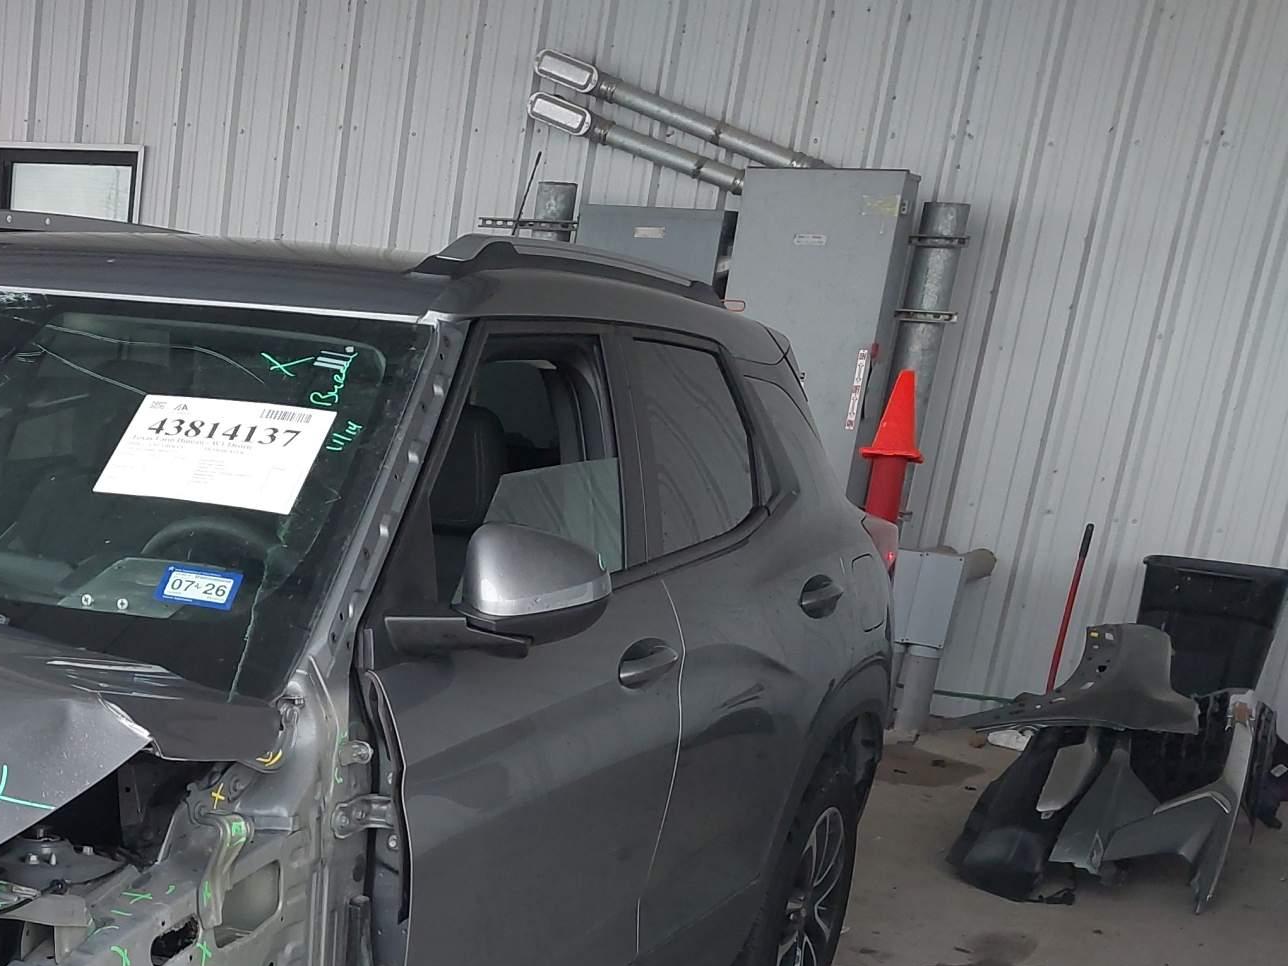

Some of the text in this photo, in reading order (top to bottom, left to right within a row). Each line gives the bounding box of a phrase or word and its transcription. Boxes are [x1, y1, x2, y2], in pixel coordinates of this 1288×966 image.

[148, 417, 302, 447] 43814137
[171, 578, 195, 592] 07
[202, 583, 227, 597] 26
